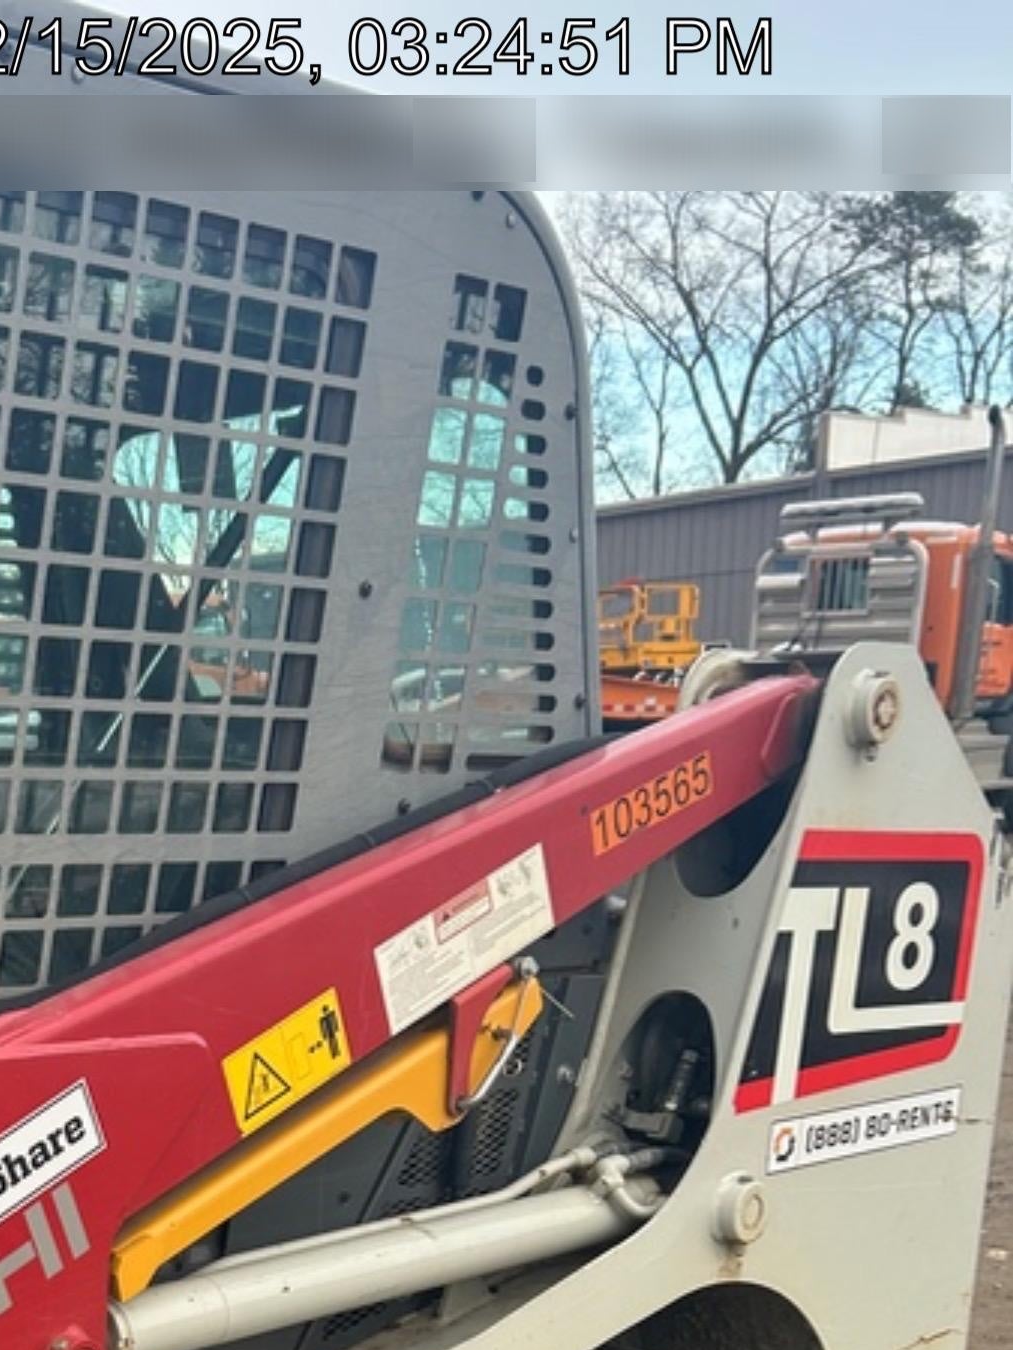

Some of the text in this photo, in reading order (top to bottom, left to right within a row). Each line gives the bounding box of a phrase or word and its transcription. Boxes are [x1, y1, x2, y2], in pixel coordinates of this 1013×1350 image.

[595, 754, 710, 848] 103565
[770, 881, 966, 1107] TL8
[806, 1117, 861, 1153] (888)
